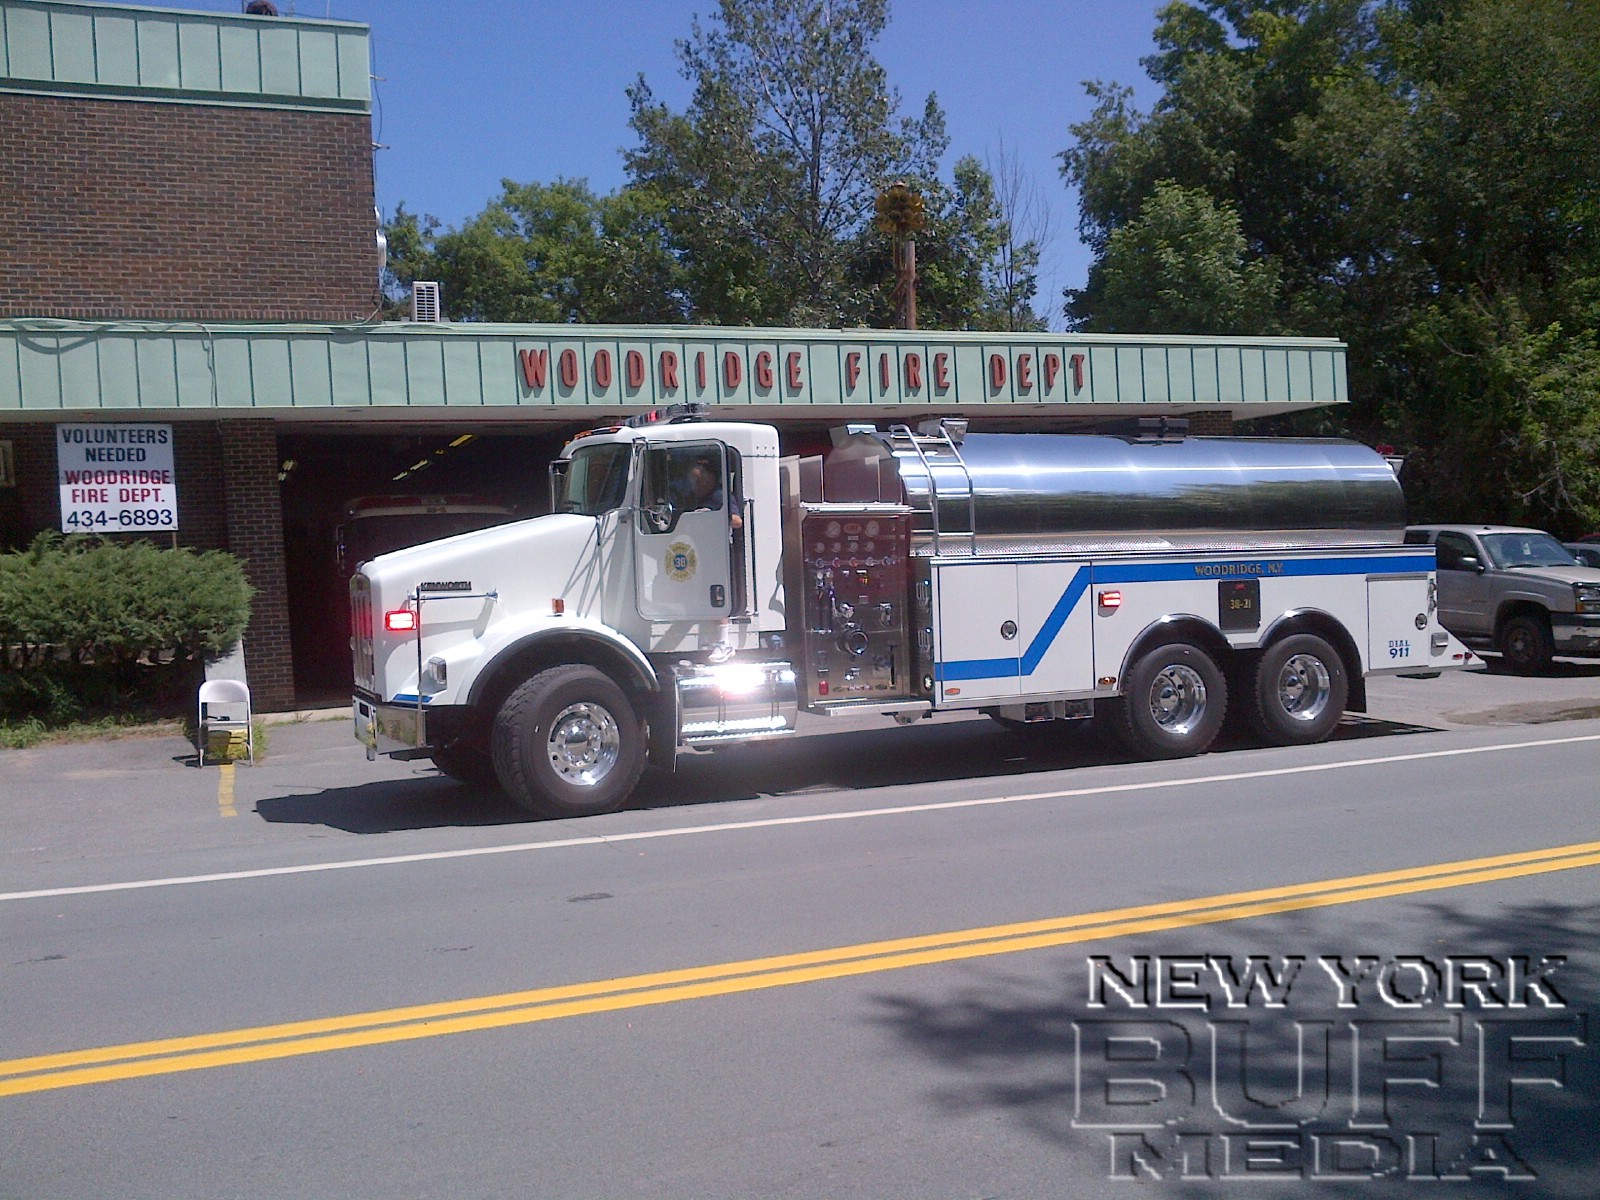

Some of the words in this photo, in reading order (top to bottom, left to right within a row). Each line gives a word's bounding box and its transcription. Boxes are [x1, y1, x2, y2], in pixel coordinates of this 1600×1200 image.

[519, 348, 804, 389] WOODRIDGE
[846, 352, 950, 389] FIRE
[989, 354, 1085, 388] DEPT
[61, 428, 168, 444] VOLUNTEERS
[85, 447, 146, 462] NEEDED
[64, 469, 171, 485] WOODRIDGE
[71, 488, 109, 503] FIRE
[119, 488, 165, 503] DEPT.
[66, 508, 173, 527] 434-6893
[420, 581, 472, 591] KENWORTH
[1388, 639, 1411, 648] DIAL
[1389, 647, 1410, 659] 911
